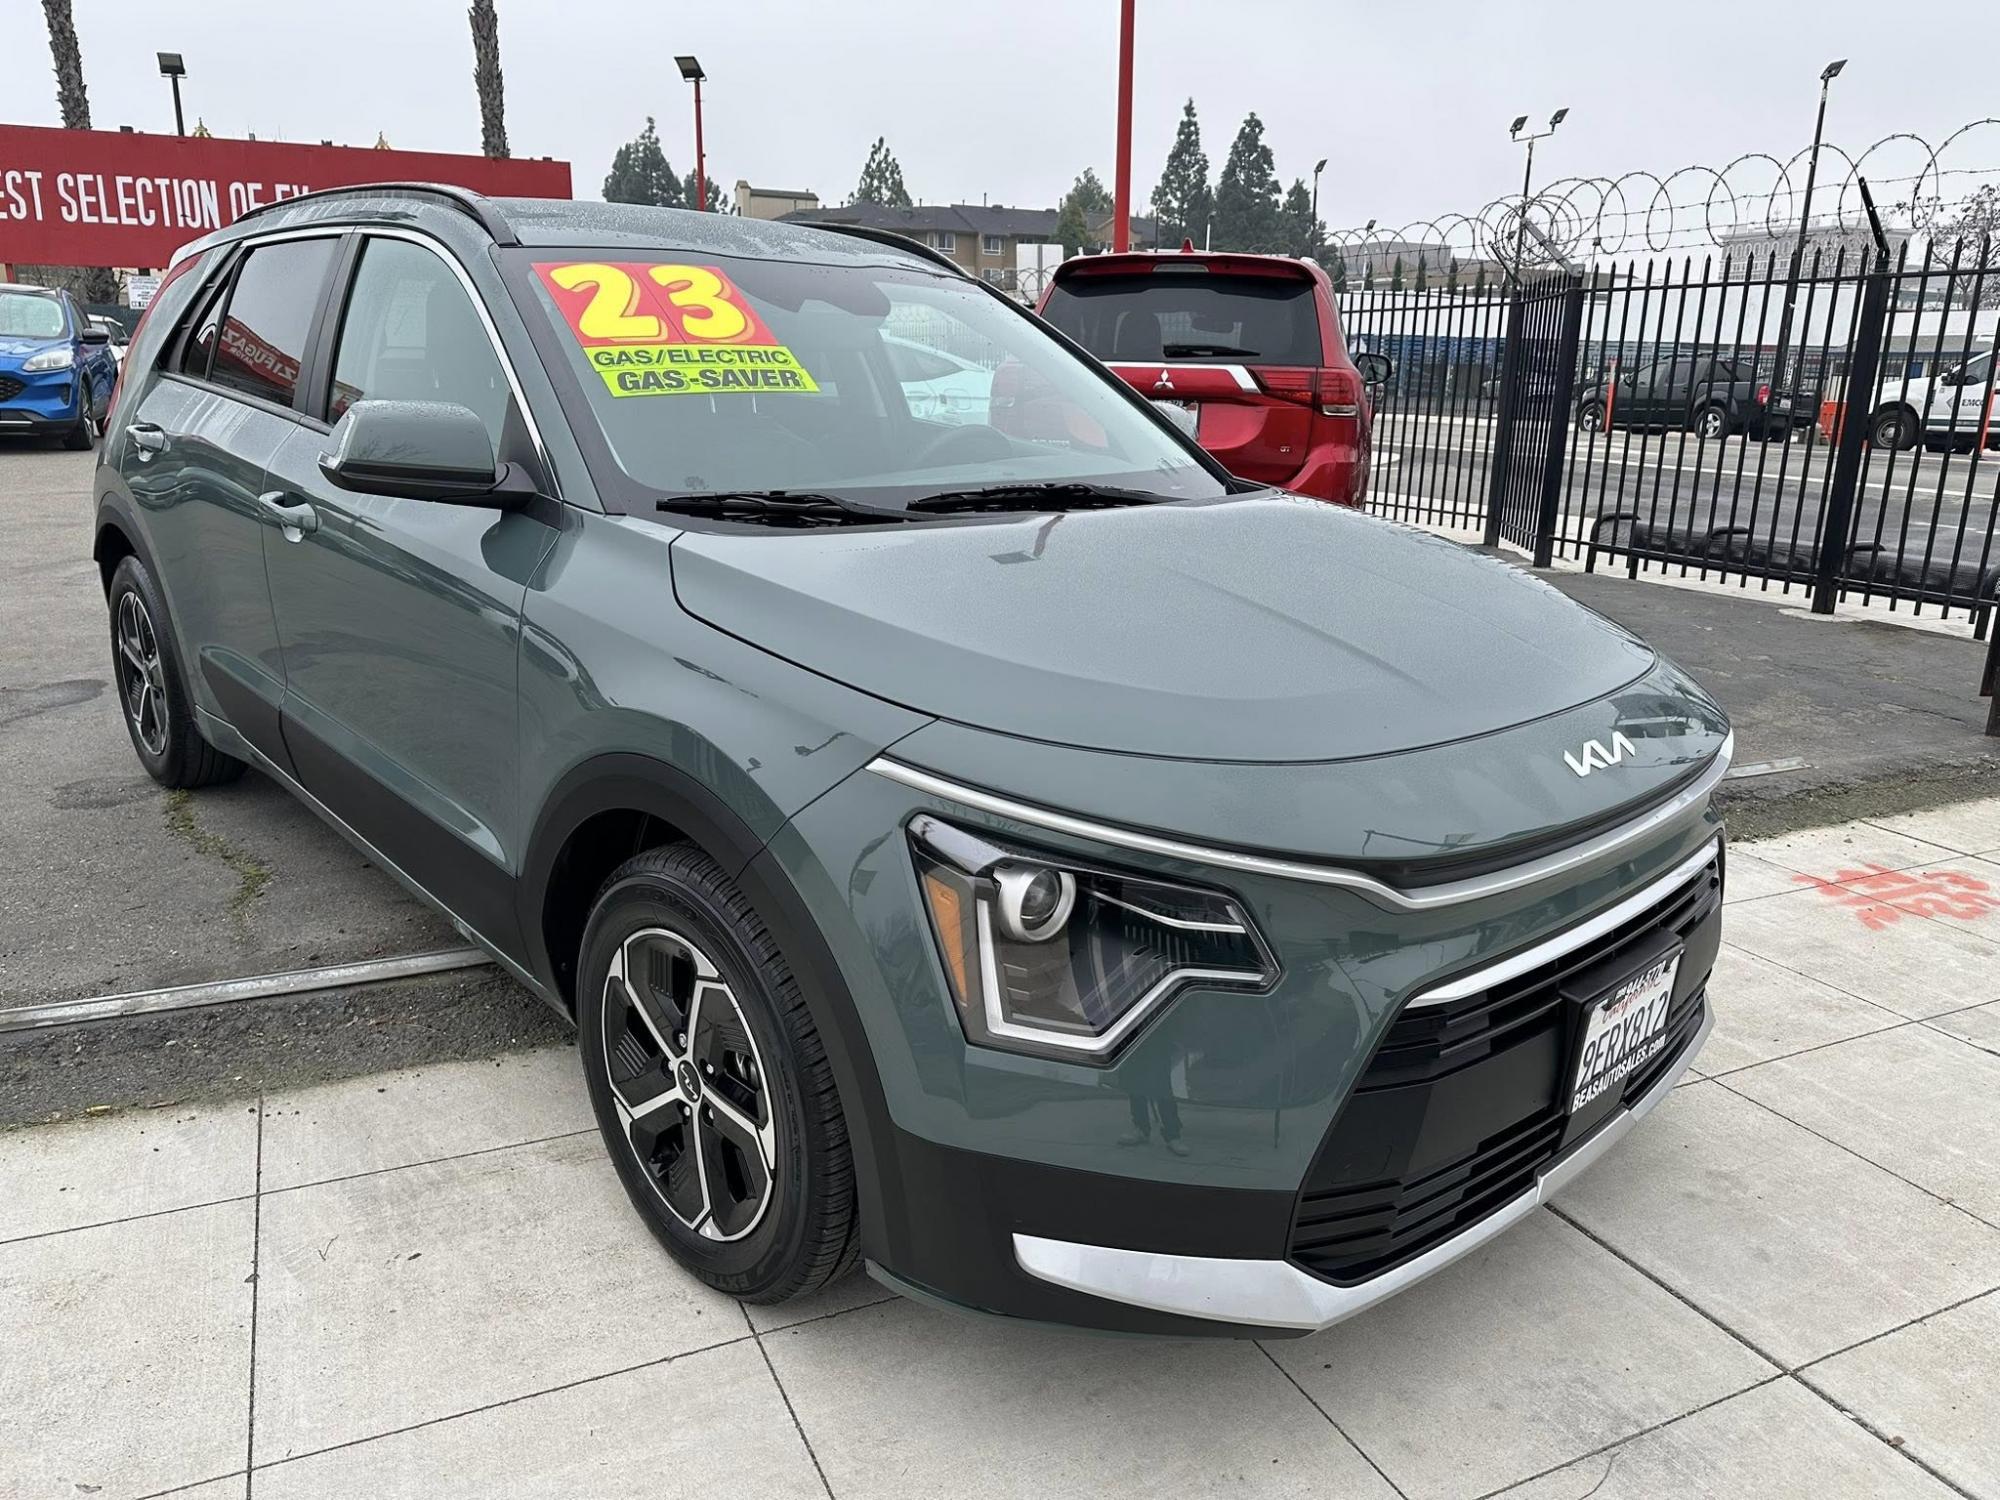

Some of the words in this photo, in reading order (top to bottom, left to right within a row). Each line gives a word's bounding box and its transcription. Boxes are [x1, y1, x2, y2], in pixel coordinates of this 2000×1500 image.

[57, 172, 221, 229] SELECTION
[549, 263, 753, 343] 23
[594, 348, 792, 367] GAS/ELECTRIC
[617, 369, 805, 392] GAS-SAVER
[1577, 990, 1670, 1089] 9ERX812
